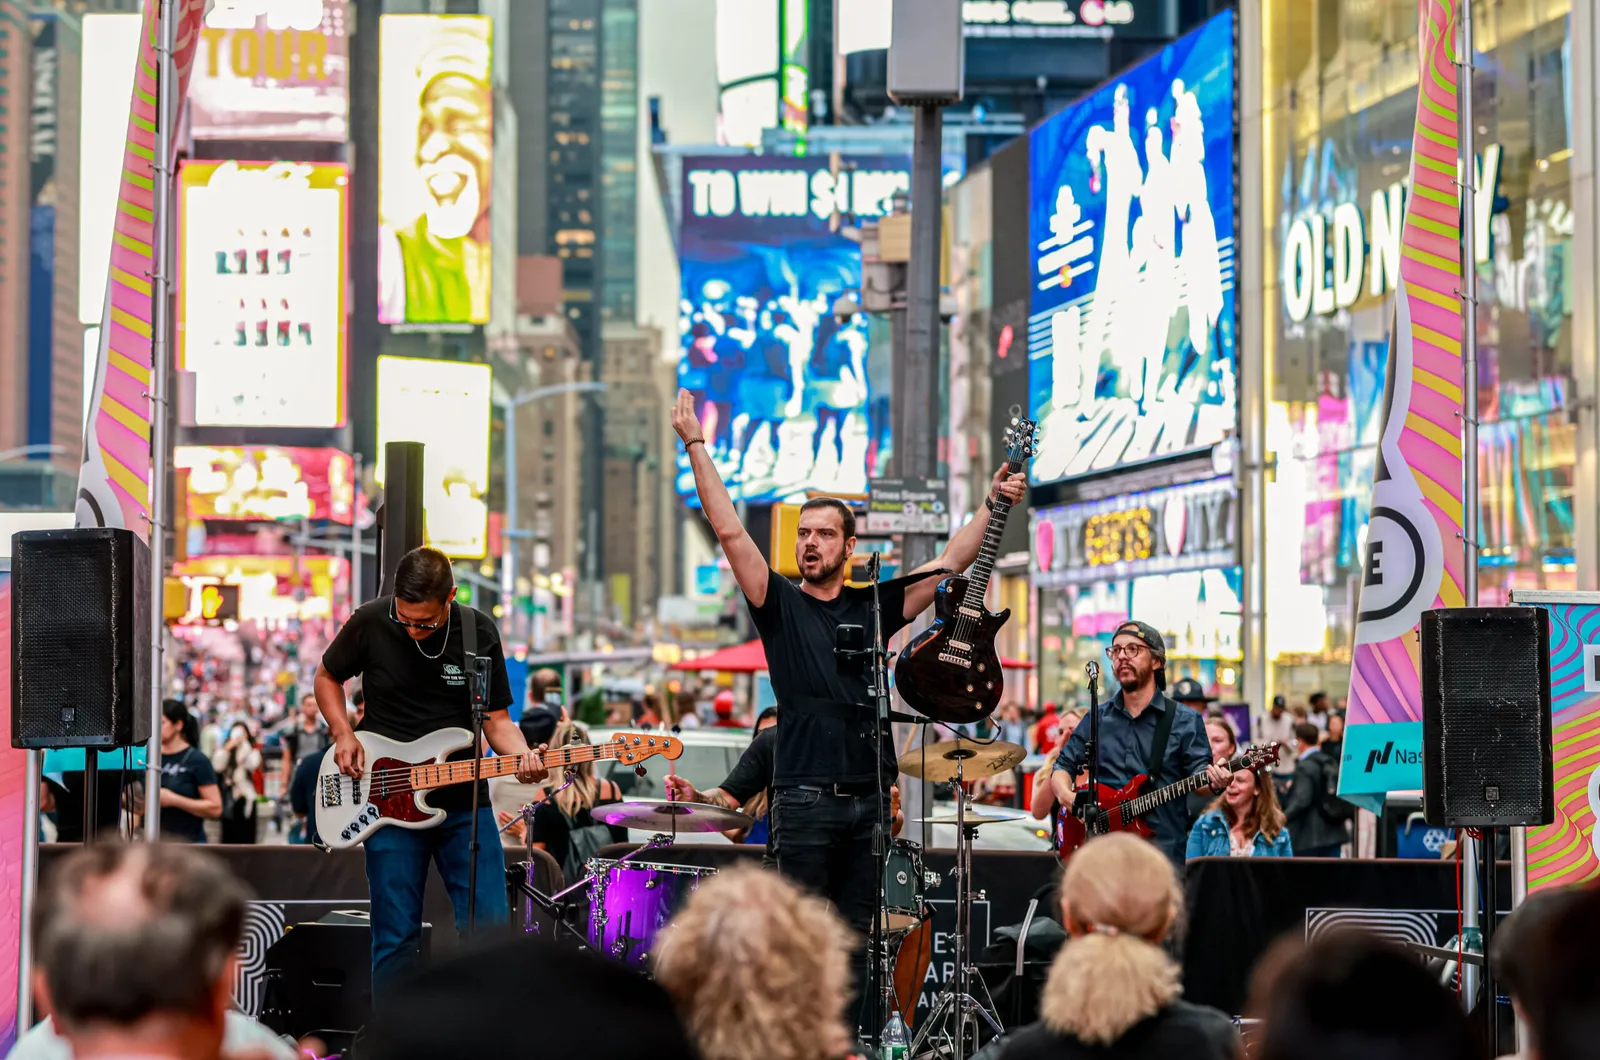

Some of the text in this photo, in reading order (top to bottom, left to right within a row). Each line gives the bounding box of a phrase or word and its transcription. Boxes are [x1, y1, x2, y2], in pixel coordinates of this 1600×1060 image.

[200, 29, 329, 82] TOUR
[688, 169, 736, 217] TO
[1284, 201, 1365, 323] OLD
